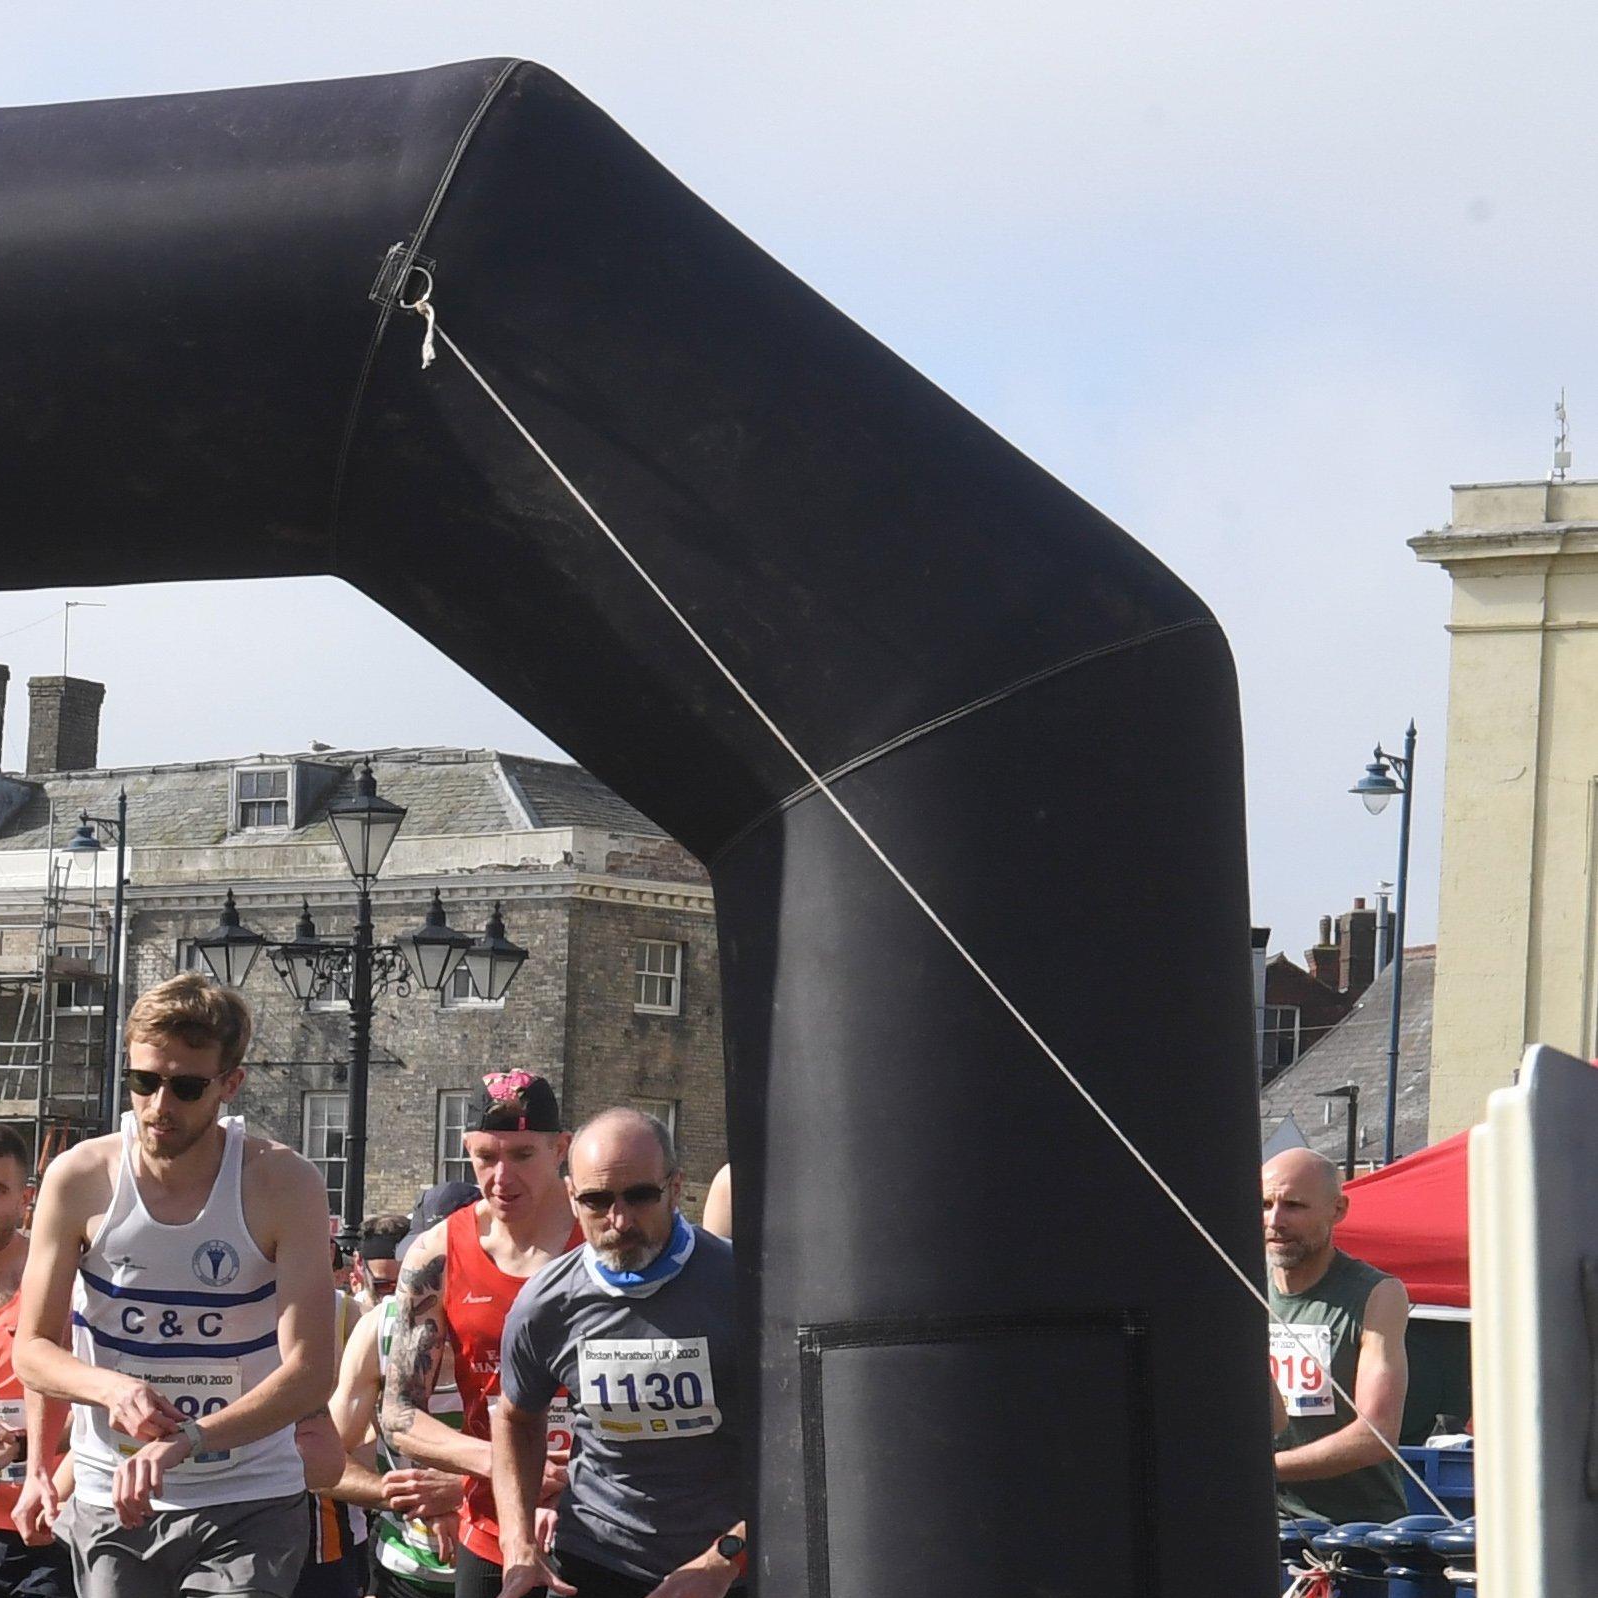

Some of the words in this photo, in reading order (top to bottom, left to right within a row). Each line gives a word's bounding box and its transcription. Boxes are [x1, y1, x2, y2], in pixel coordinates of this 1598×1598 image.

[121, 1306, 146, 1334] C
[159, 1310, 183, 1338] &
[197, 1312, 223, 1337] C
[585, 1350, 613, 1361] Boston
[614, 1350, 653, 1361] Marathon
[654, 1349, 675, 1362] (UK)
[676, 1348, 701, 1359] 2020
[144, 1373, 185, 1385] Marathon
[186, 1374, 209, 1386] (UK)
[209, 1374, 234, 1386] 2020
[590, 1371, 704, 1413] 1130
